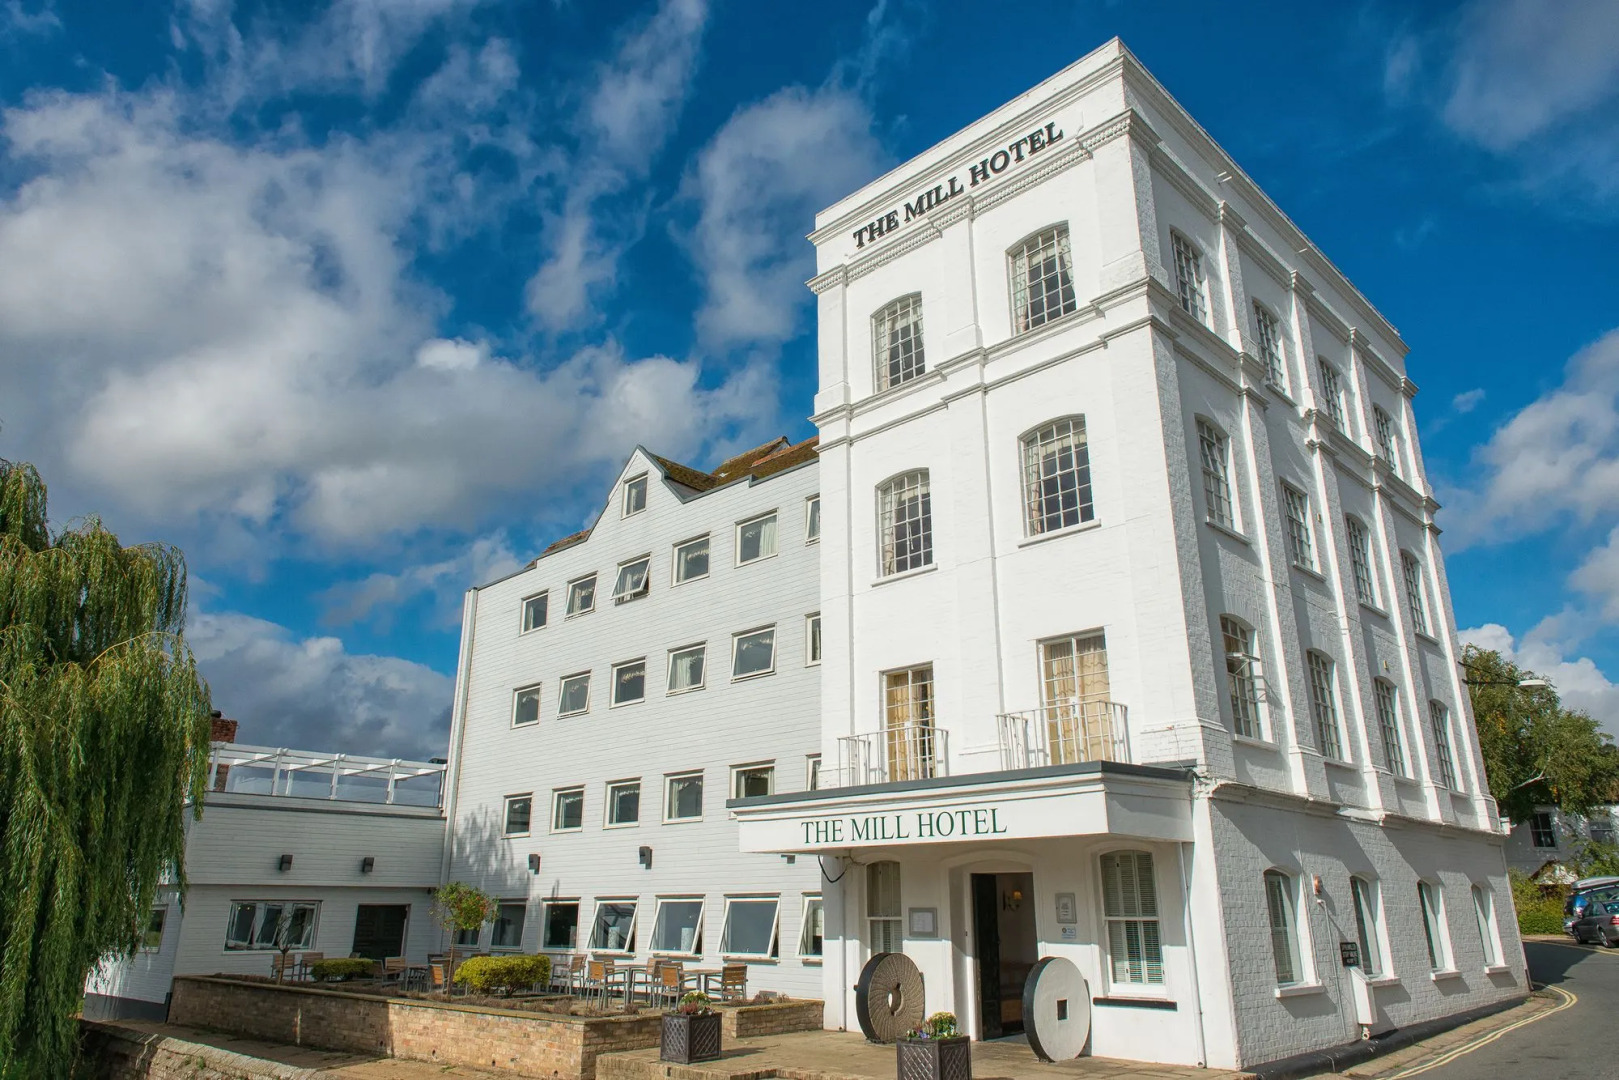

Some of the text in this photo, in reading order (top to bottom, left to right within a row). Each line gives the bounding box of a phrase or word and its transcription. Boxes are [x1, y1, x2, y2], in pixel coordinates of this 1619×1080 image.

[853, 121, 1064, 249] THE MILL HOTEL
[801, 808, 1008, 844] THE MILL HOTEL
